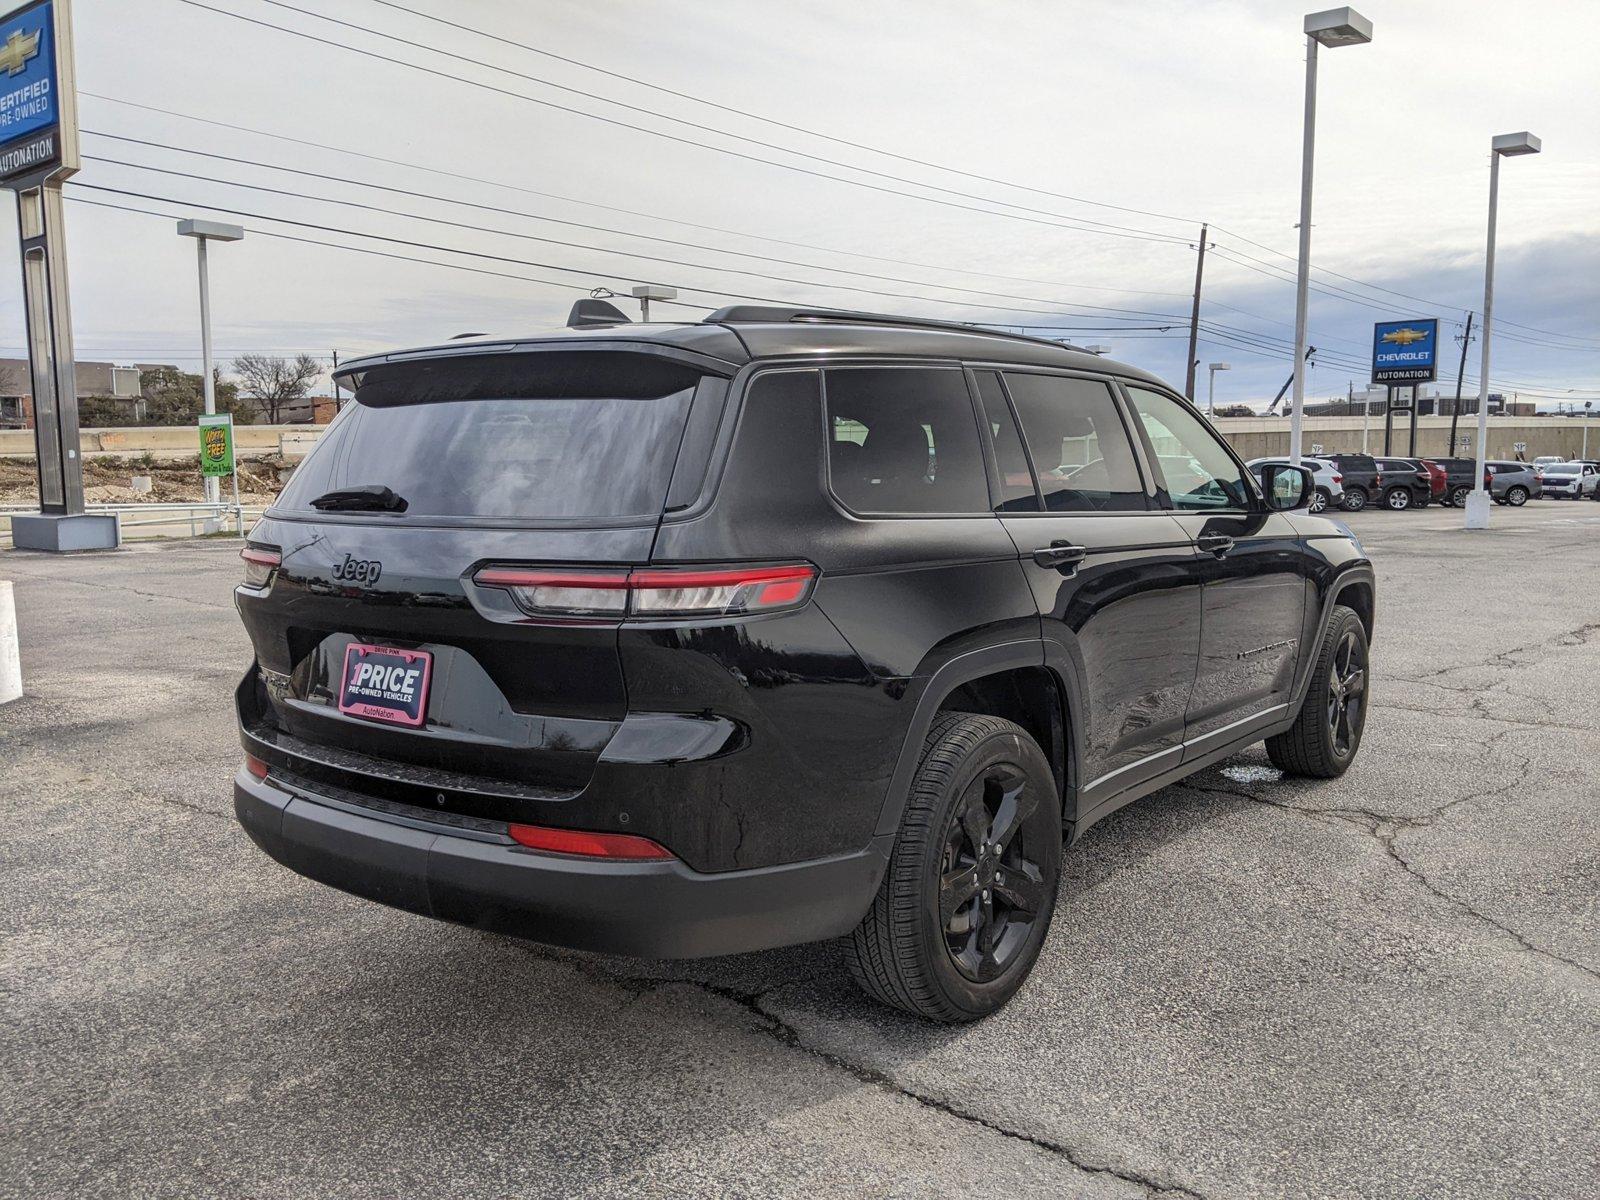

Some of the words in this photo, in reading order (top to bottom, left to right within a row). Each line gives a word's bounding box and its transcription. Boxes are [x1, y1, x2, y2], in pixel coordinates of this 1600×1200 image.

[0, 78, 50, 111] ERTIFIED
[1377, 351, 1430, 362] CHEVROLET
[1377, 370, 1430, 380] AUTONATION
[207, 443, 226, 456] FREE
[331, 553, 382, 588] Jeep
[389, 648, 400, 656] PINK
[350, 662, 420, 694] 1PRICE
[347, 685, 382, 698] PRE-OWNED
[383, 691, 413, 703] VEHICLES
[362, 706, 394, 719] AutoNation
